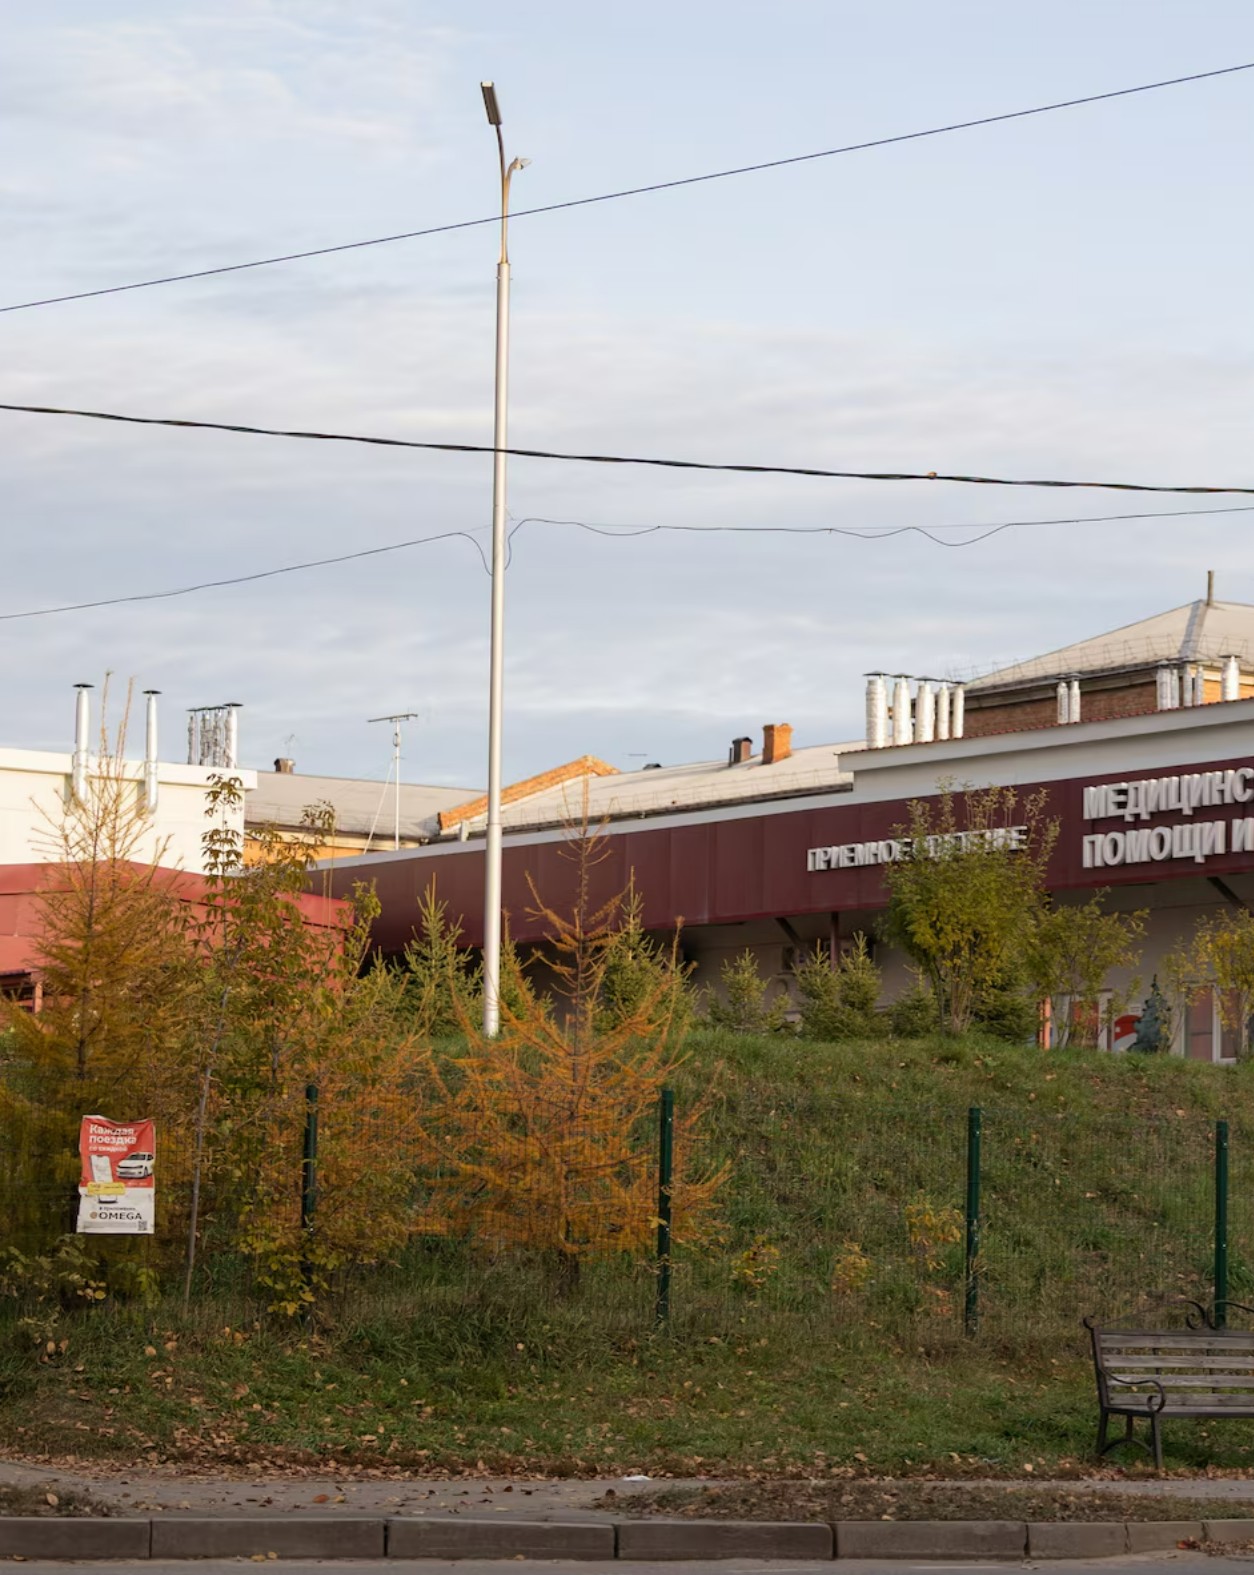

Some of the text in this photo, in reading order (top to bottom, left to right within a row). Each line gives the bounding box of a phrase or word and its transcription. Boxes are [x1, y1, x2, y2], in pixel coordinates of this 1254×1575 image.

[807, 838, 912, 872] ПРИЕМНОЕ
[1082, 820, 1226, 868] ПОМОЩИ
[99, 1212, 142, 1220] OMEGA
